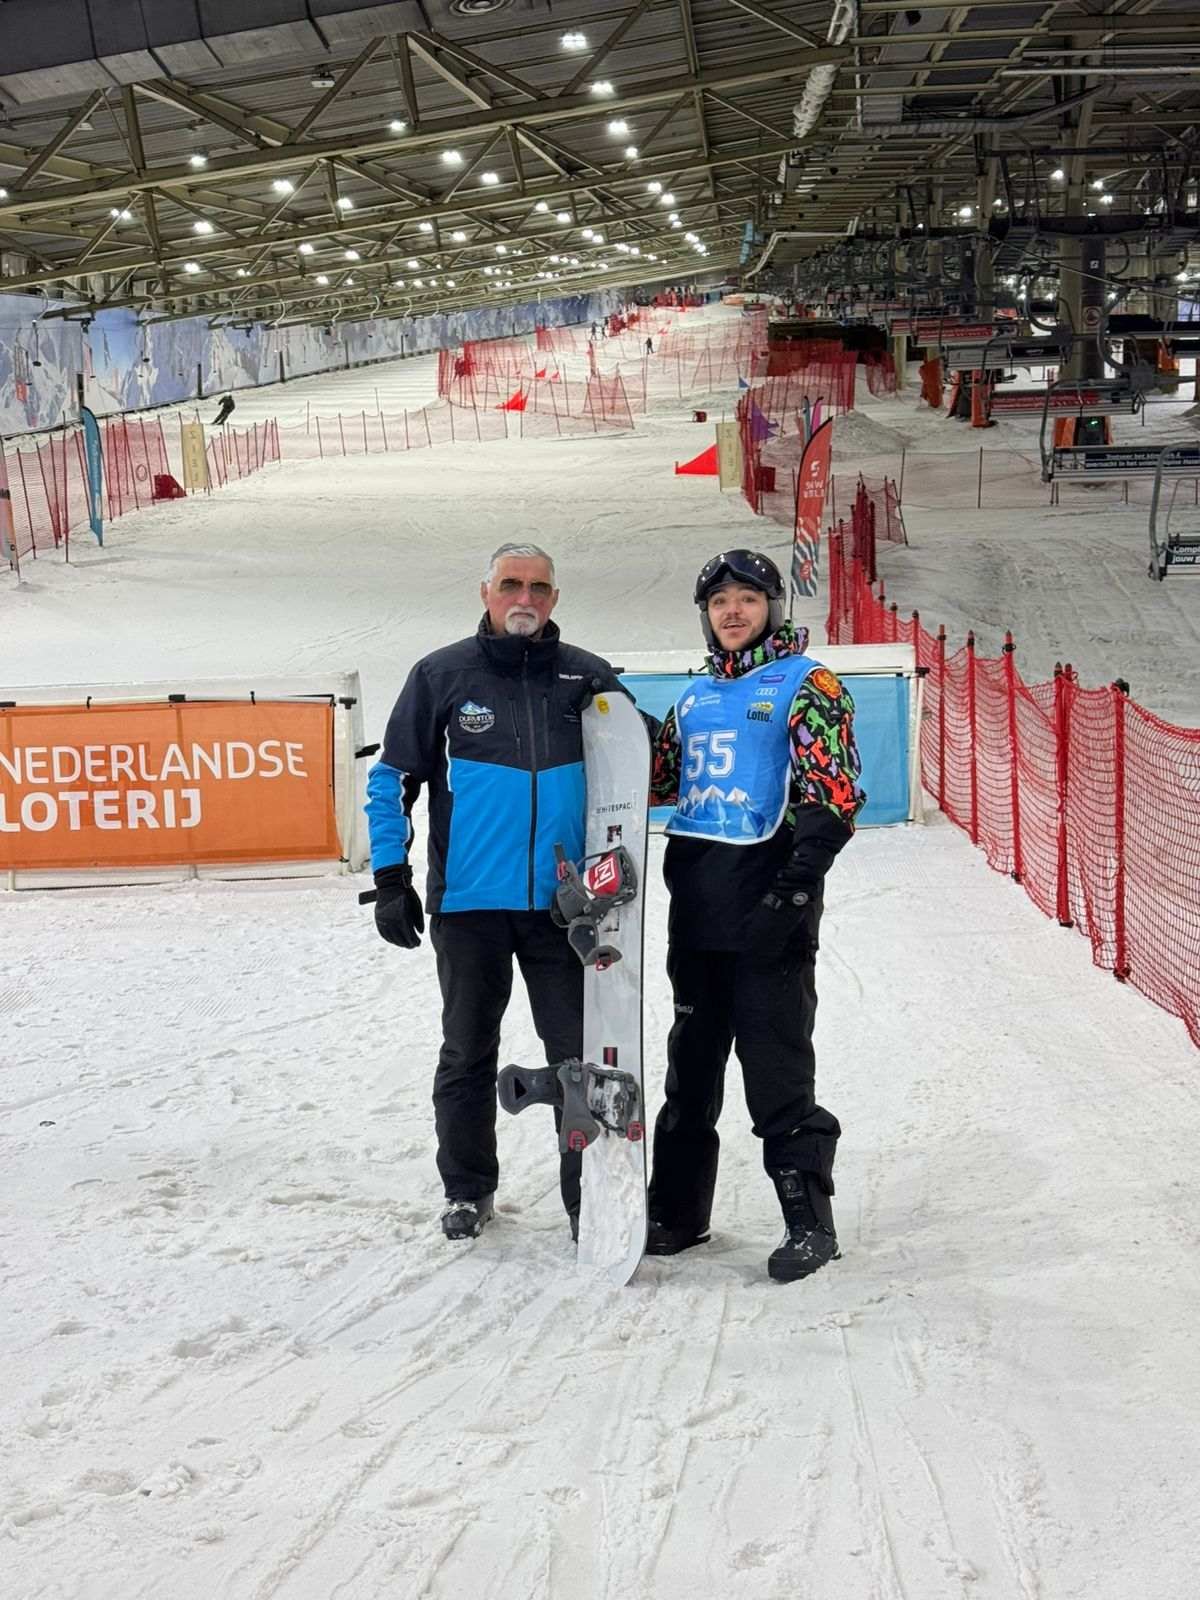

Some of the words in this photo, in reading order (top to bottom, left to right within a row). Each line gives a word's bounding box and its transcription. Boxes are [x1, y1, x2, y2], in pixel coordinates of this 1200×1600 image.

[0, 740, 308, 785] NEDERLANDSE
[686, 729, 738, 781] 55
[0, 788, 202, 833] LOTERIJ
